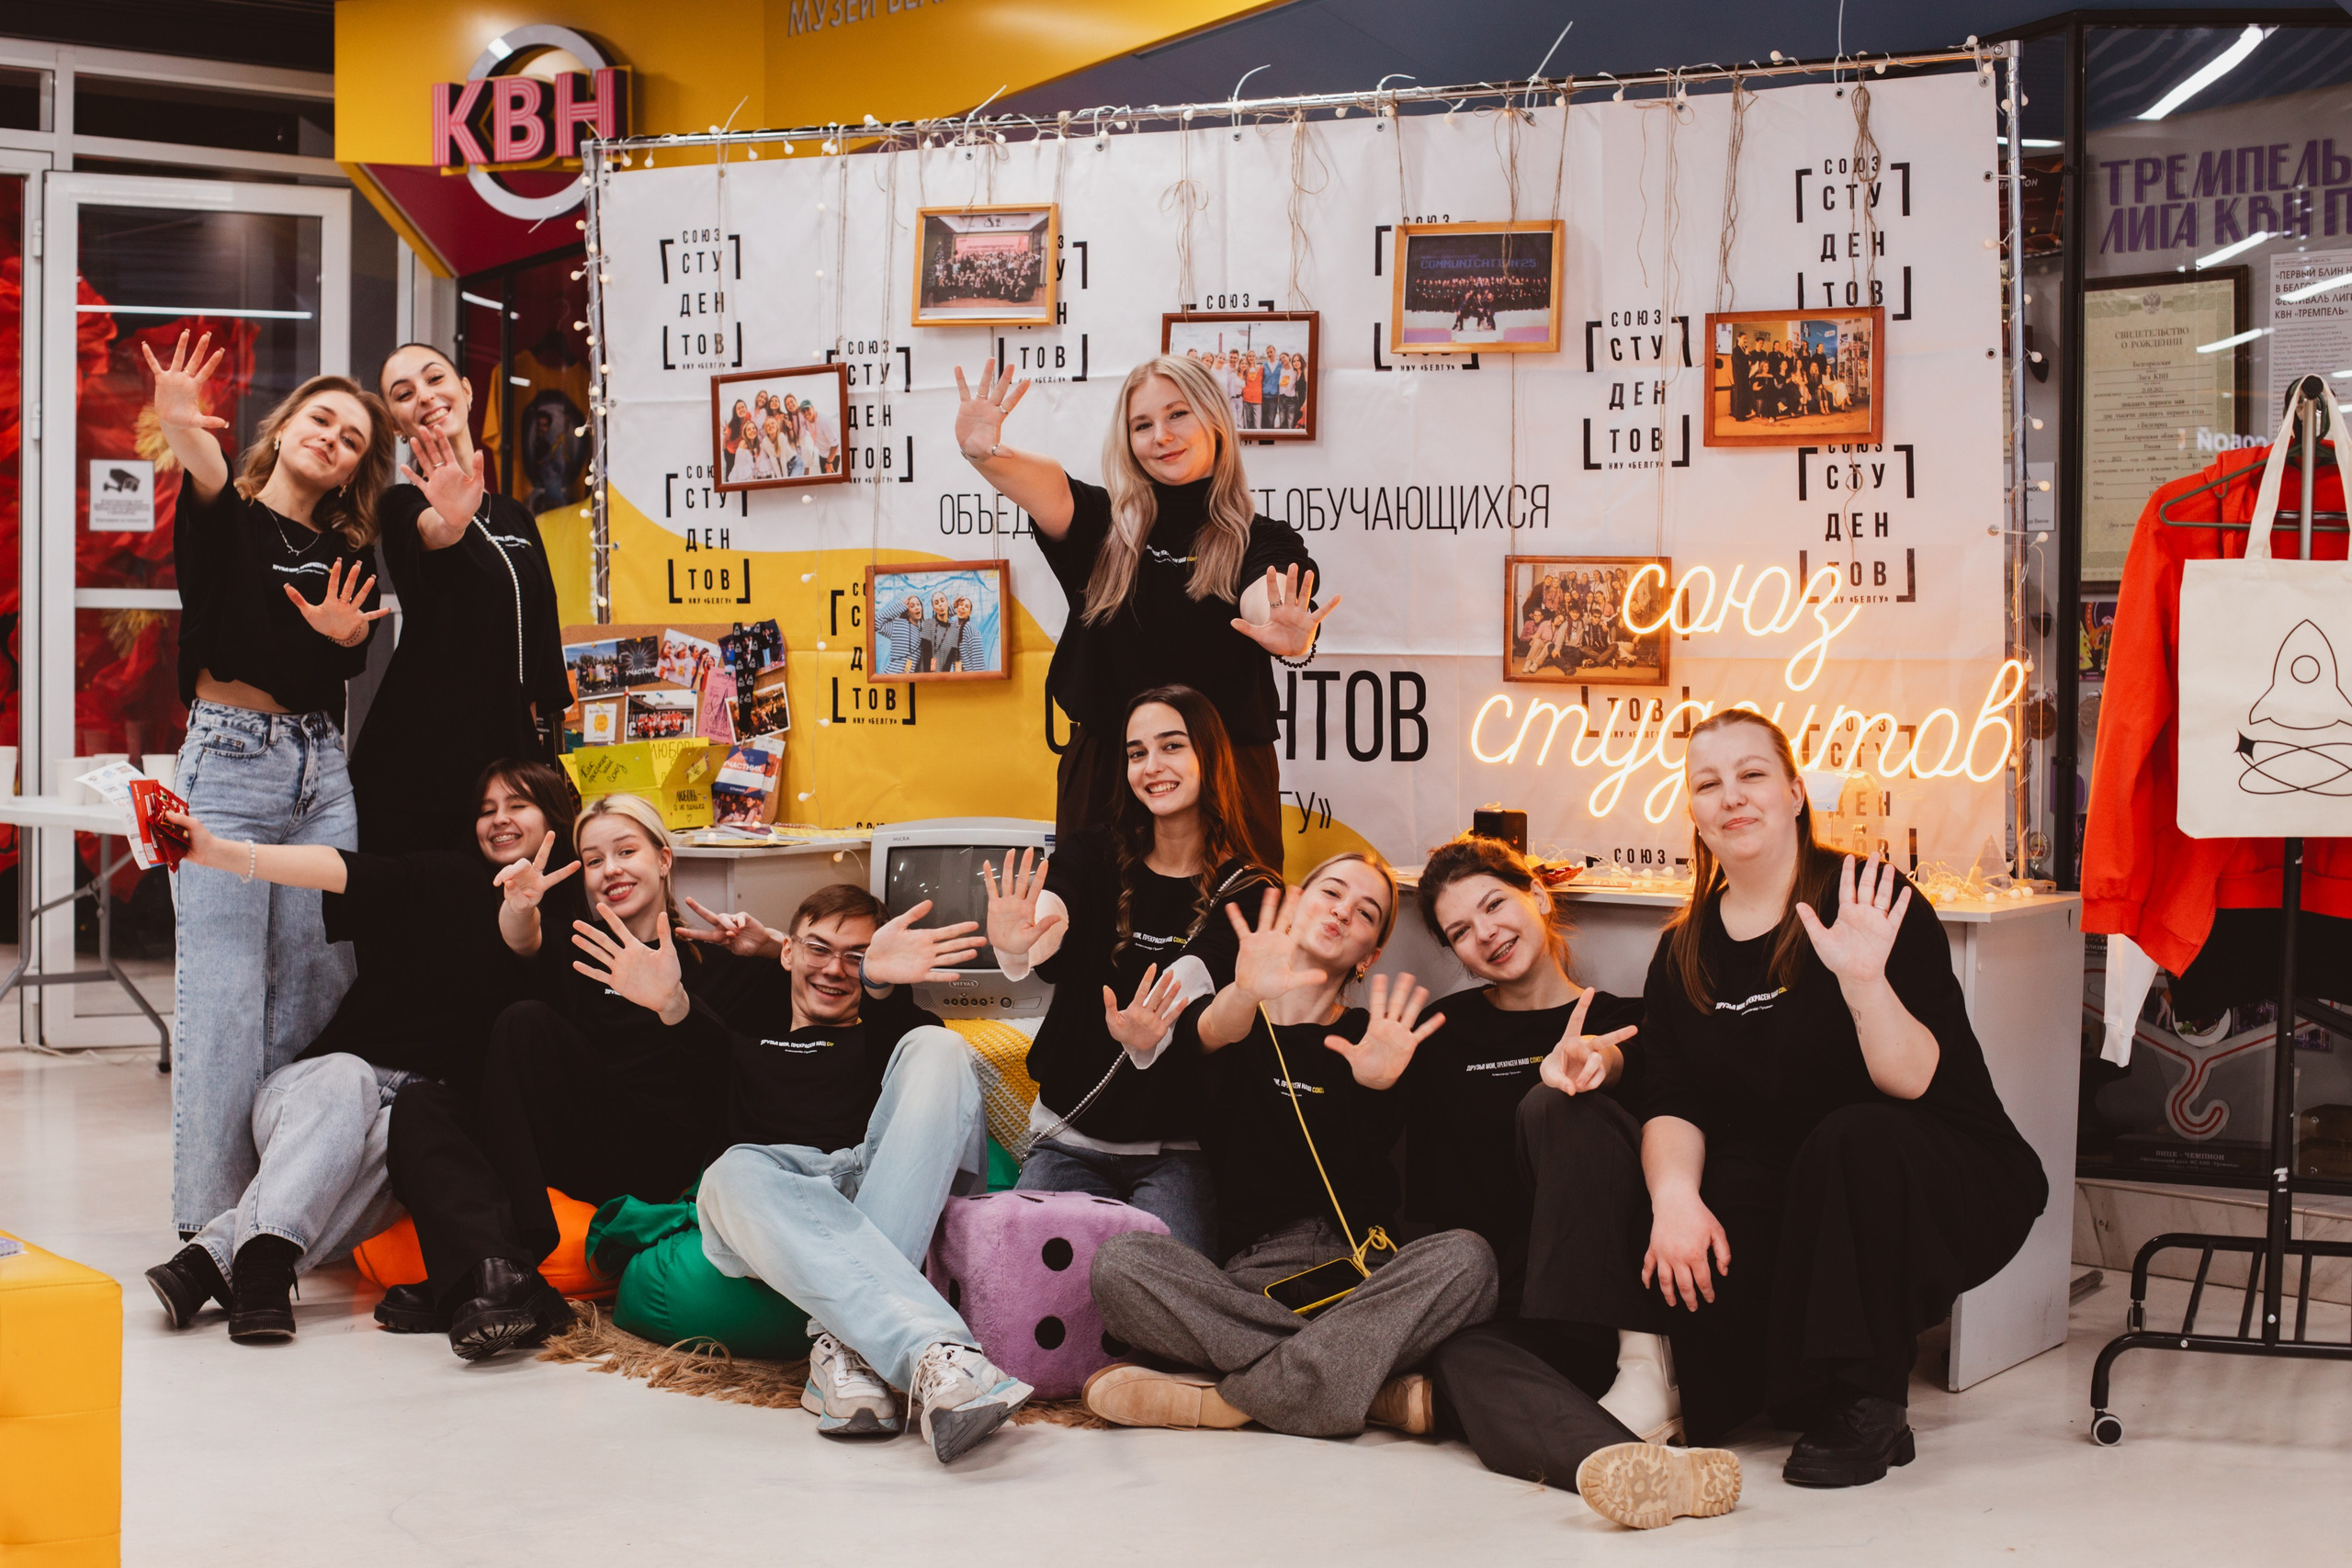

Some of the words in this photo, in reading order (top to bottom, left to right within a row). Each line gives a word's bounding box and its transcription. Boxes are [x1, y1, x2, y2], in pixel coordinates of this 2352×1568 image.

[432, 67, 617, 166] КВН
[1824, 156, 1880, 175] СОЮЗ
[2099, 139, 2352, 206] ТРЕМПЕЛЬ
[1822, 182, 1882, 210] СТУ
[2099, 202, 2199, 254] ЛИГА
[2215, 191, 2311, 245] КВН
[682, 228, 721, 243] СОЮЗ
[1820, 231, 1884, 263] ДЕН
[682, 251, 723, 274] СТУ
[2276, 267, 2315, 279] «ПЕРВЫЙ
[2318, 266, 2344, 276] БЛИН
[1822, 280, 1883, 307] ТОВ
[2276, 284, 2280, 293] В
[680, 291, 725, 318] ДЕН
[1206, 293, 1250, 309] СОЮЗ
[2275, 310, 2292, 319] КВН
[2294, 306, 2348, 318] «ТРЕМПЕЛЬ»
[1611, 310, 1662, 327] СОЮЗ
[682, 333, 725, 356] ТОВ
[2114, 326, 2189, 340] СВИДЕТЕЛЬСТВО
[2131, 337, 2183, 349] РОЖДЕНИИ
[847, 340, 889, 355] СОЮЗ
[1020, 345, 1065, 369] ТОВ
[1610, 335, 1664, 361] СТУ
[847, 363, 890, 387] СТУ
[1609, 380, 1666, 410] ДЕН
[848, 404, 891, 430] ДЕН
[1609, 427, 1664, 454] ТОВ
[849, 446, 892, 469] ТОВ
[686, 465, 715, 479] СОЮ
[1826, 463, 1885, 490] СТУ
[685, 488, 727, 509] СТУ
[1286, 484, 1550, 535] ОБУЧАЮЩИХСЯ
[1825, 512, 1888, 541] ДЕН
[685, 528, 729, 552] ДЕН
[688, 569, 729, 590] ТОВ
[1826, 561, 1887, 587] ТОВ
[1849, 595, 1889, 604] «БЕЛГУ»
[853, 688, 896, 710] ТОВ
[1607, 697, 1663, 723] ТОВ
[724, 761, 763, 773] УЧАСТНИК
[1614, 848, 1666, 864] СОЮЗ
[1497, 1059, 1518, 1068] ПРЕКРАСЕН
[1517, 1057, 1530, 1066] НАШ
[2185, 1152, 2224, 1161] ЧЕМПИОН
